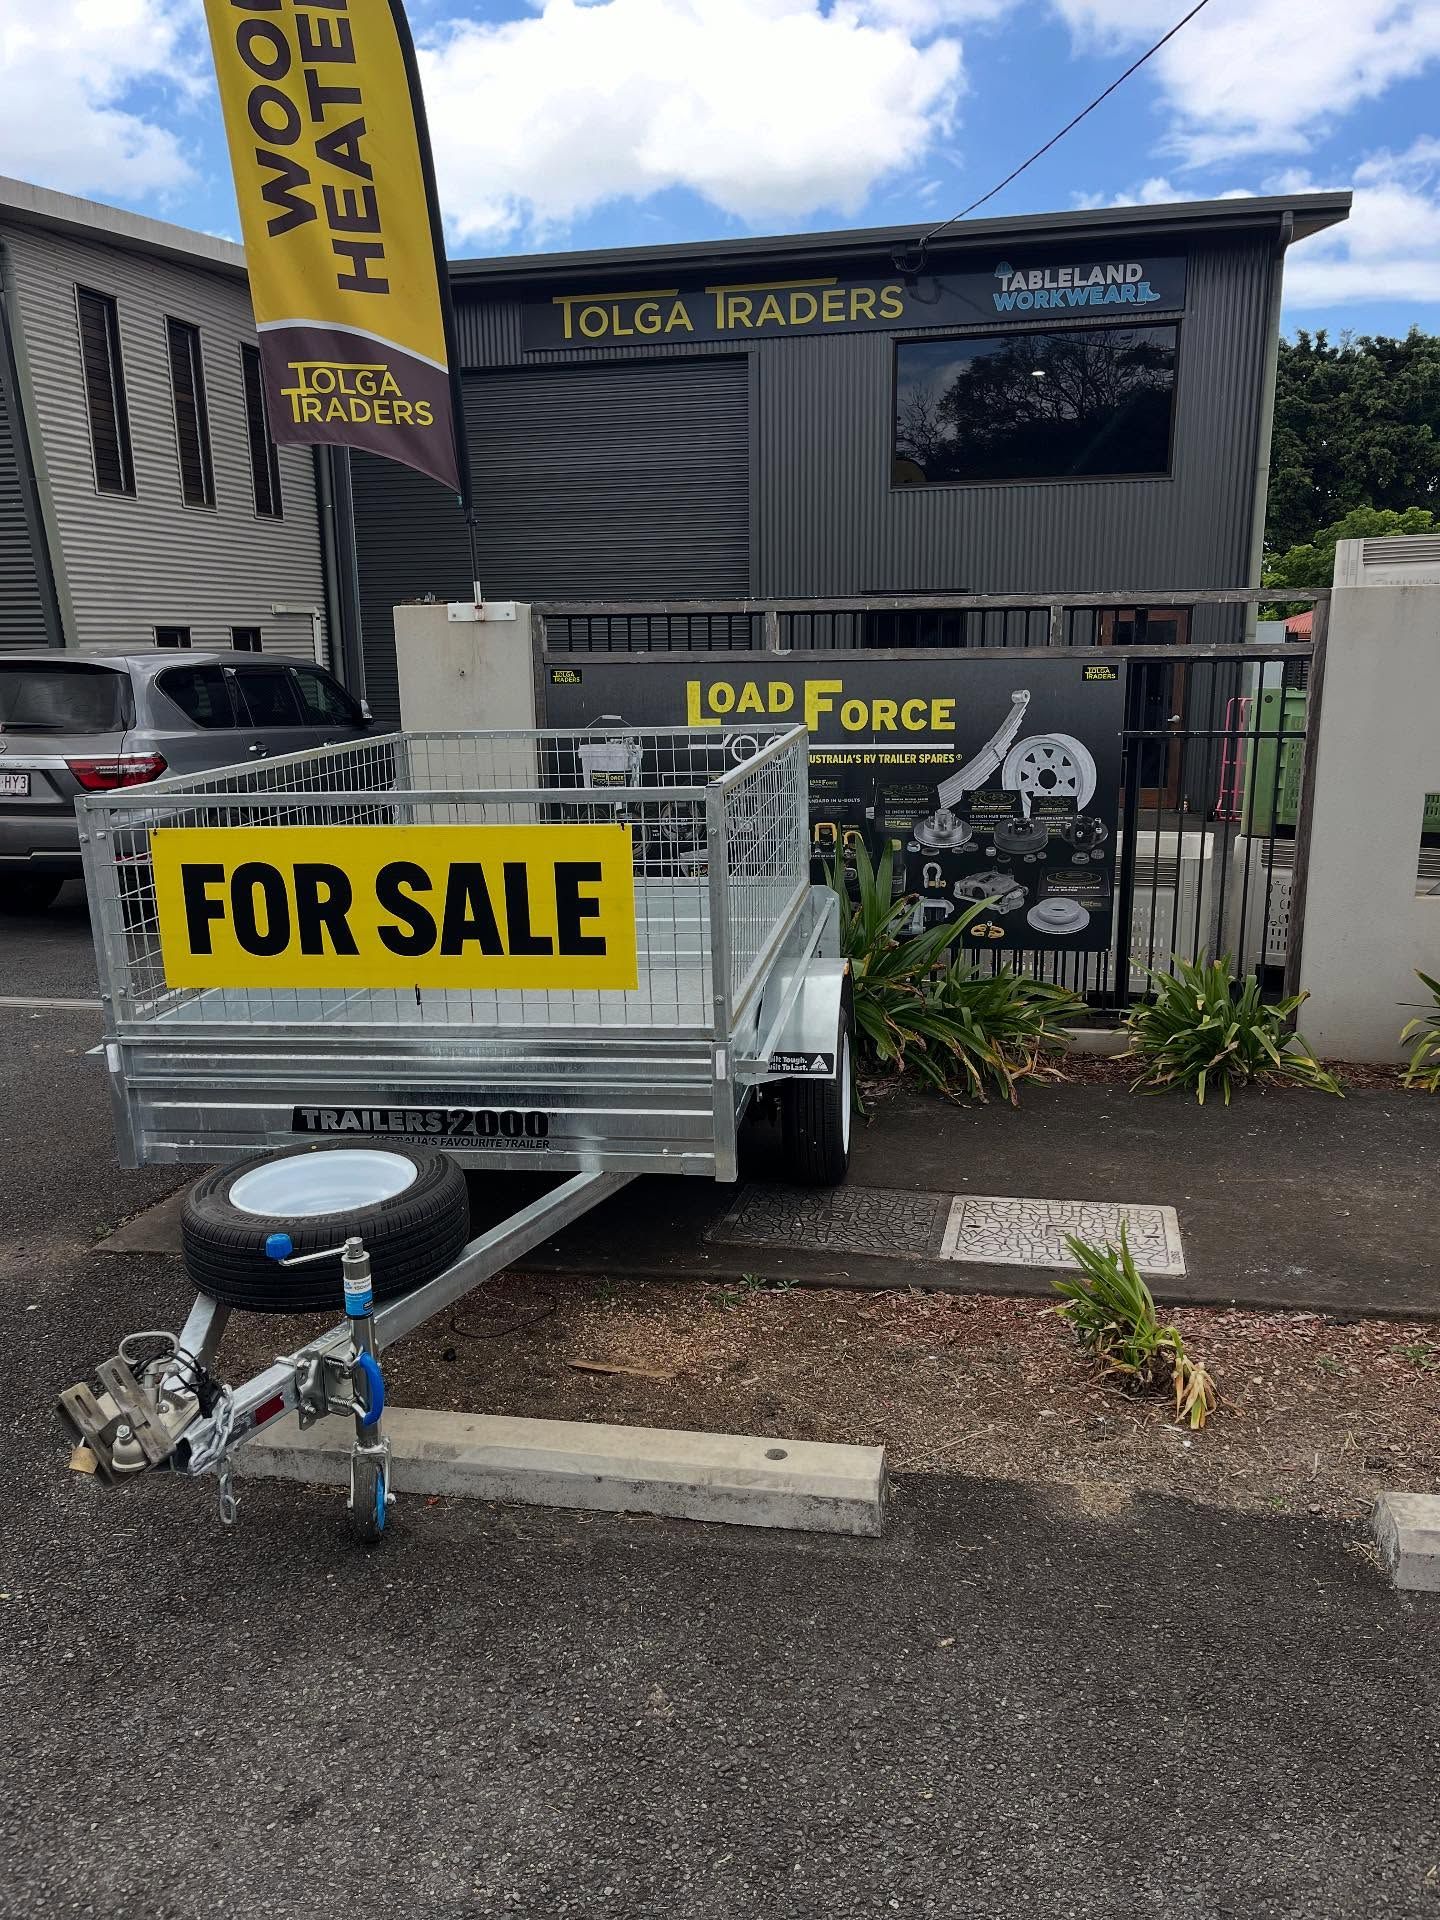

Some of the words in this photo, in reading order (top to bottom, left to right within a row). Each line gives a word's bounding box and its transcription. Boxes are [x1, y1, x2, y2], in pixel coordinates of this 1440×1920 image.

[230, 0, 318, 237] WOO
[293, 0, 390, 294] HEATE
[996, 263, 1143, 291] TABLELAND
[553, 288, 694, 339] TOLGA
[705, 277, 904, 329] TRADERS
[993, 284, 1139, 312] WORKWEAR
[288, 362, 402, 397] TOLGA
[280, 387, 434, 426] TRADERS
[552, 675, 581, 683] TRADERS
[1085, 671, 1116, 680] TRADERS
[1087, 666, 1110, 674] TOLGA
[687, 681, 794, 727] LOAD
[804, 680, 956, 731] FORCE
[808, 753, 862, 764] USTRALIA'S
[863, 753, 876, 764] RV
[878, 753, 917, 764] TRAILER
[180, 861, 360, 957] FOR
[375, 861, 607, 957] SALE
[782, 1056, 807, 1065] Tough.
[782, 1063, 791, 1071] To
[791, 1063, 809, 1072] Last.
[301, 1109, 443, 1133] TRAILERS
[440, 1137, 503, 1148] FAVOURITE
[505, 1139, 550, 1149] TRAILER
